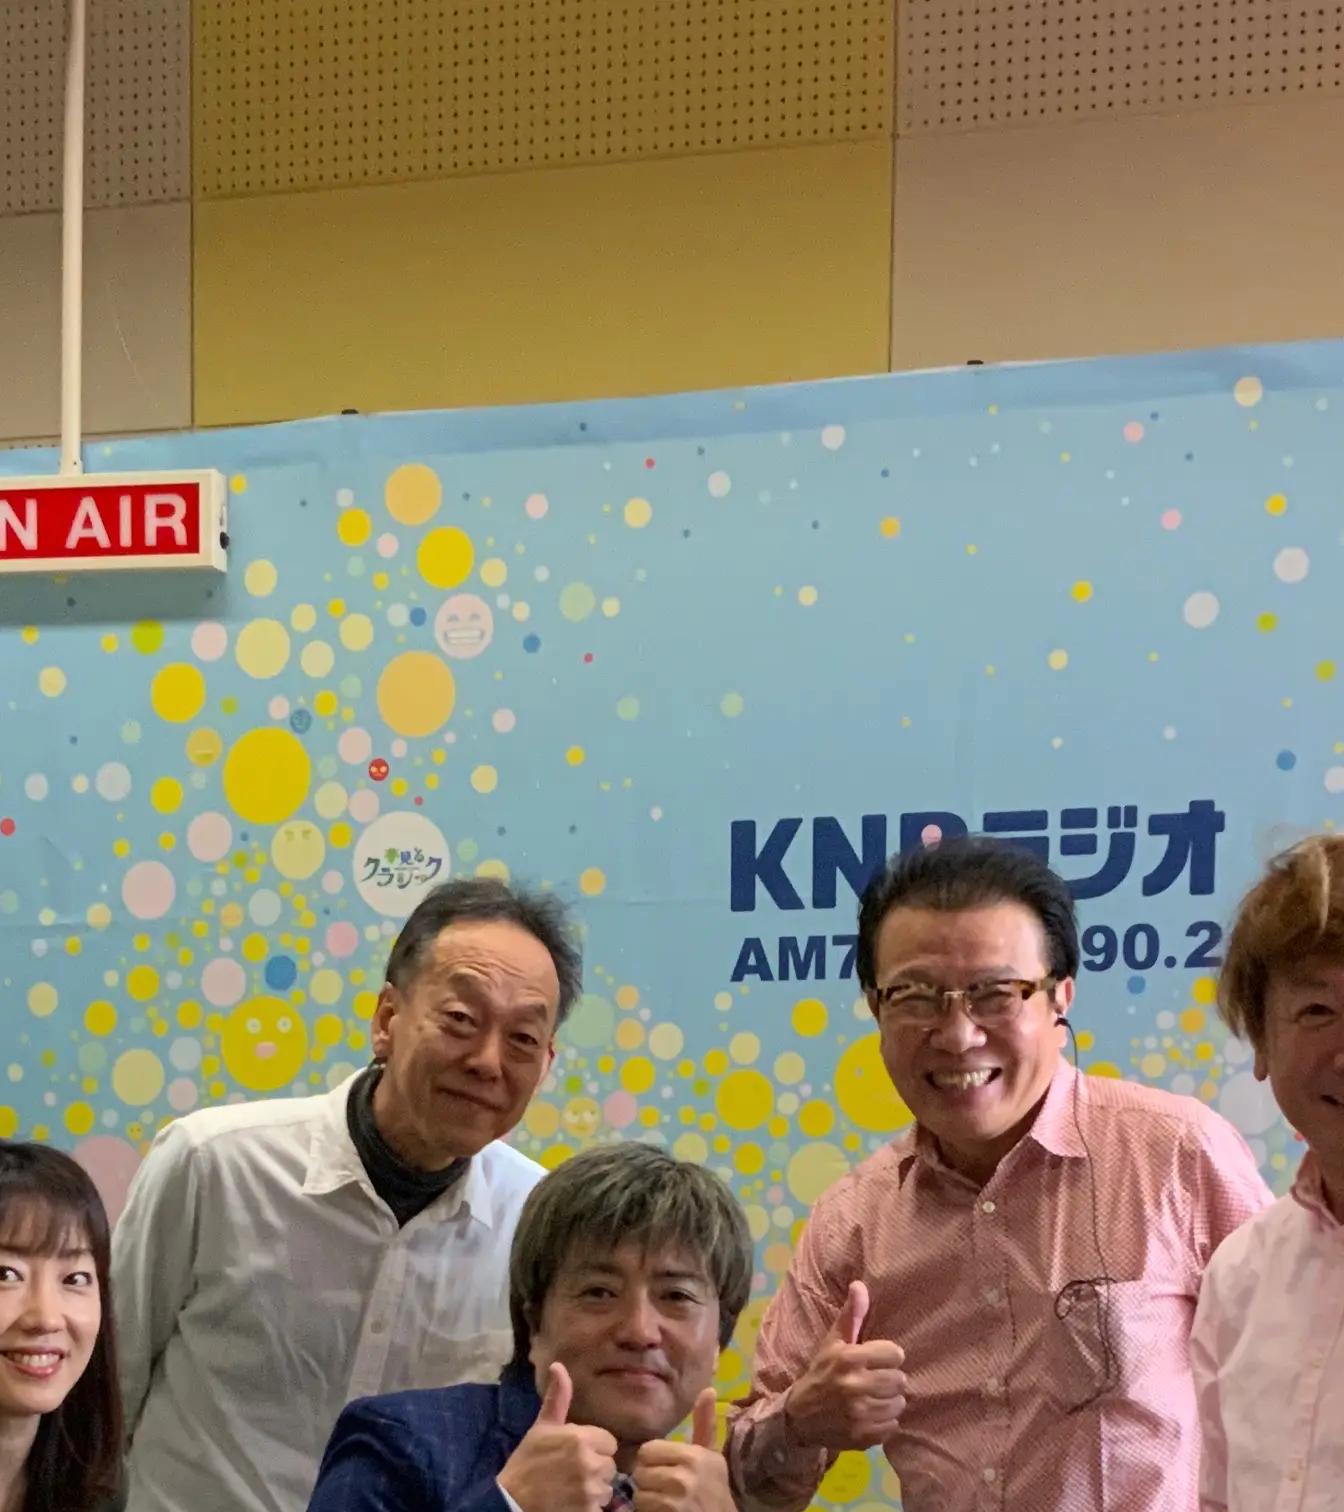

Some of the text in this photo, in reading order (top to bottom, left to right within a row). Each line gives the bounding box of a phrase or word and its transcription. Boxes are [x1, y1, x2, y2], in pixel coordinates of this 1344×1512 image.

[65, 492, 188, 550] AIR
[730, 920, 1224, 983] AM7 90.2
